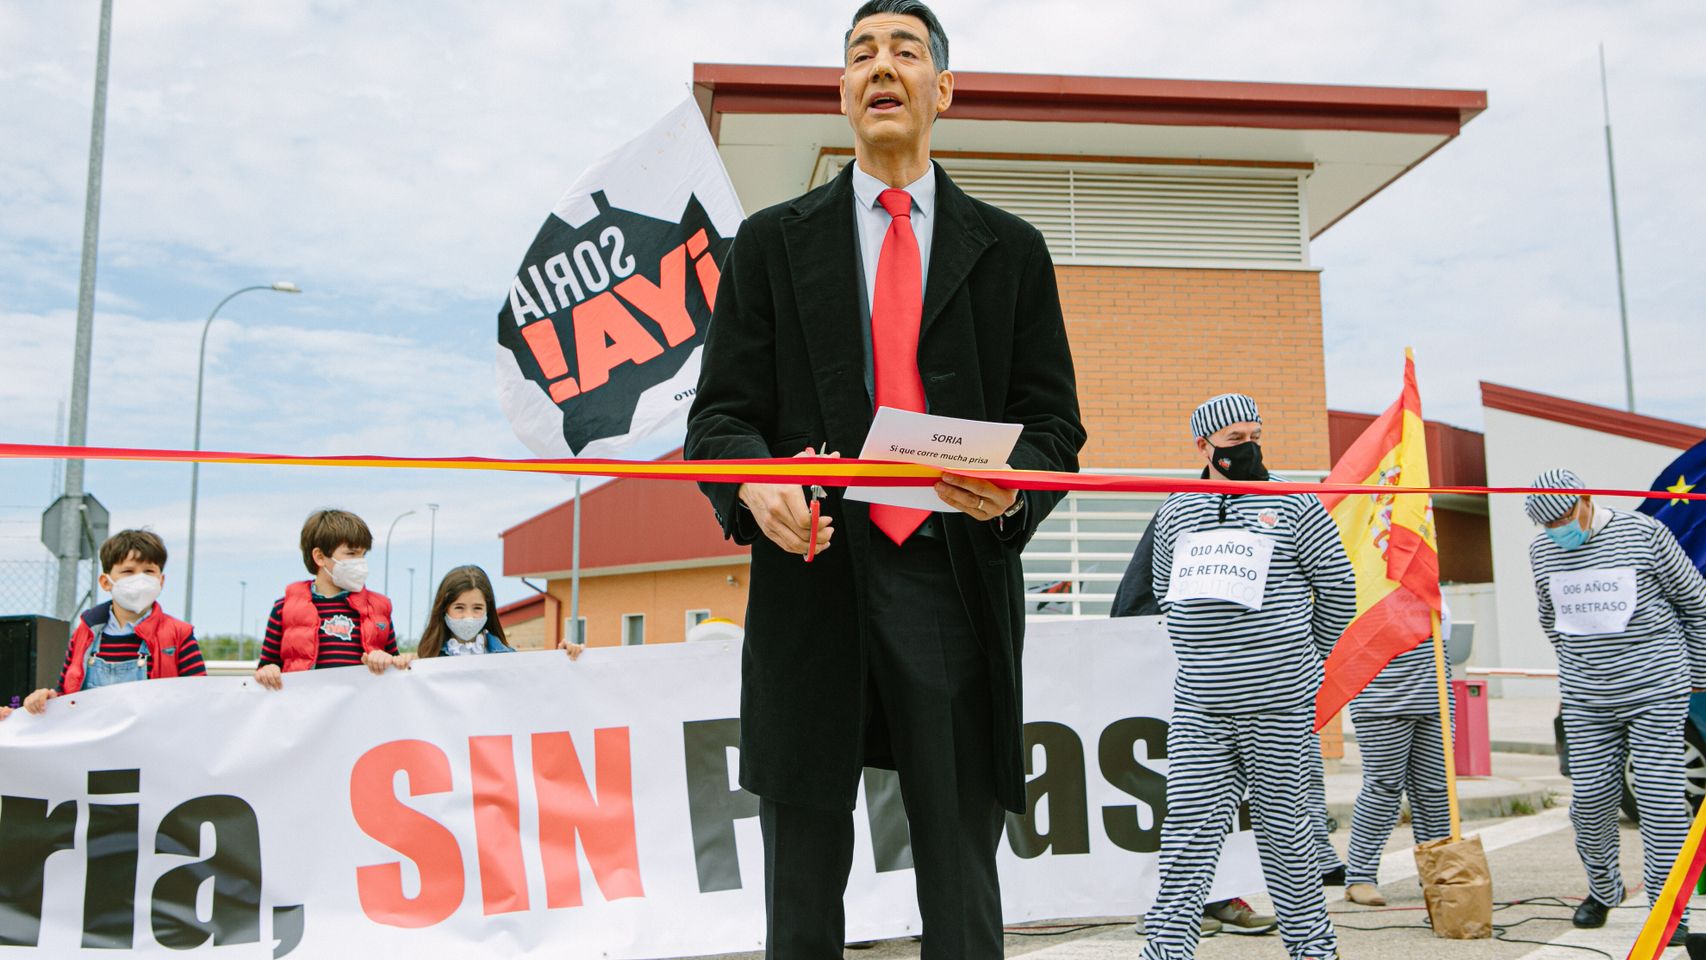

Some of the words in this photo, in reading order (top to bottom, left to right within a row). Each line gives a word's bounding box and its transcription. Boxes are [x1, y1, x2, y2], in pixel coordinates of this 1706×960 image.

[931, 434, 962, 445] SORIA
[899, 449, 916, 457] que
[917, 450, 939, 459] corre
[940, 452, 968, 463] mucha
[969, 456, 989, 466] prisa
[1191, 545, 1212, 556] 010
[1214, 542, 1253, 557] AÑOS
[1179, 567, 1194, 578] DE
[1197, 564, 1257, 580] RETRASO
[1563, 584, 1581, 595] 006
[1585, 580, 1618, 592] AÑOS
[1561, 604, 1574, 615] DE
[1576, 602, 1627, 613] RETRASO
[350, 726, 646, 929] SIN
